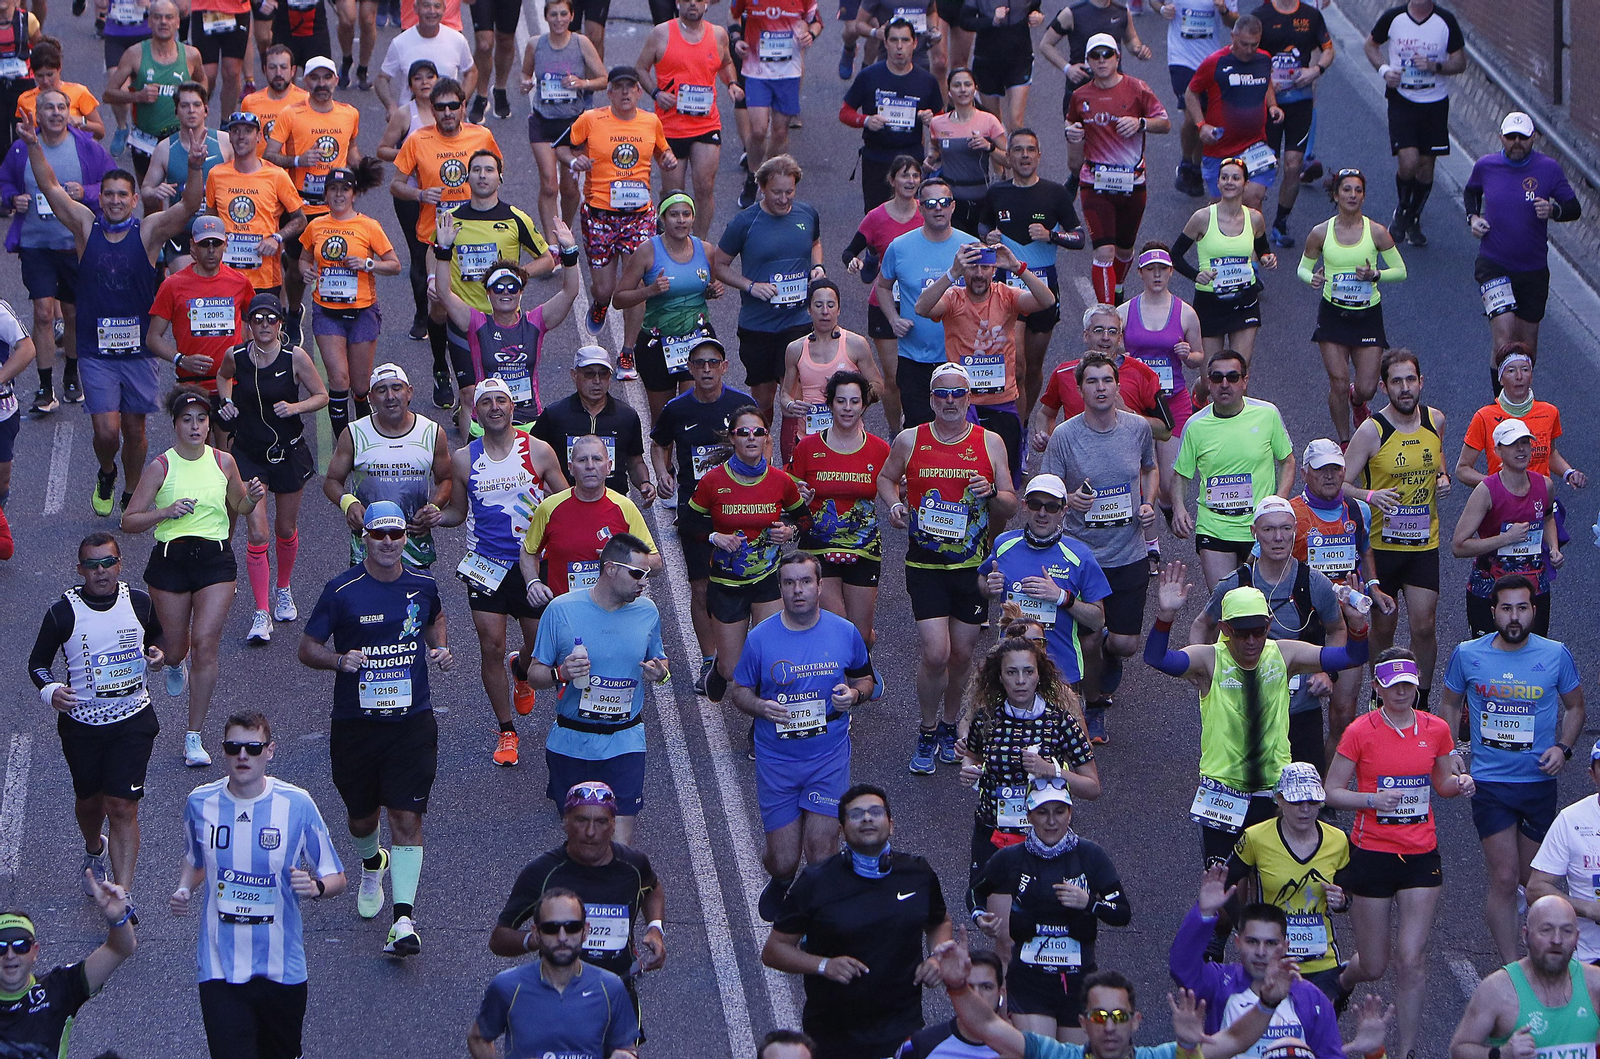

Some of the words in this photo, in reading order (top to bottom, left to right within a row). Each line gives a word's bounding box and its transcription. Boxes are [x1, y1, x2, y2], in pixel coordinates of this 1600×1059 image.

[436, 151, 468, 160] PAMPLONA
[612, 156, 638, 169] RUNNERS
[228, 188, 259, 196] PAMPLONA
[1525, 191, 1535, 201] 50
[230, 210, 255, 224] RUNNERS
[322, 229, 356, 237] PAMPLONA
[235, 234, 259, 242] ZURICH
[1223, 257, 1247, 265] ZURICH
[784, 272, 806, 282] ZURICH
[1221, 278, 1243, 286] CRISTINA
[1485, 278, 1508, 291] ZURICH
[1342, 285, 1362, 293] 13472
[206, 299, 231, 307] ZURICH
[111, 319, 136, 327] ZURICH
[1143, 358, 1168, 366] ZURICH
[503, 371, 526, 380] ZURICH
[392, 462, 411, 470] CROSS
[479, 476, 516, 487] PINTURAS
[816, 472, 872, 484] INDEPENDIENTES
[1401, 477, 1426, 486] TEAM
[1099, 486, 1126, 497] ZURICH
[1220, 491, 1239, 500] 7152
[722, 503, 777, 515] INDEPENDIENTES
[936, 502, 964, 513] ZURICH
[1100, 503, 1119, 512] 9205
[1226, 501, 1249, 509] ANTONIO
[1400, 507, 1427, 515] ZURICH
[374, 517, 397, 527] URUGUAY
[930, 514, 955, 526] 12656
[1398, 521, 1418, 530] 7150
[1391, 531, 1423, 539] FRANCISCO
[1324, 537, 1351, 545] ZURICH
[1321, 550, 1345, 559] 14010
[474, 559, 497, 576] 12614
[1326, 562, 1353, 570] VETERANO
[468, 570, 487, 584] DANIEL
[1020, 599, 1043, 609] 12281
[362, 642, 418, 657] MARCELO
[109, 651, 138, 663] ZURICH
[82, 634, 95, 691] ZAPADOR
[362, 655, 417, 670] URUGUAY
[790, 661, 839, 673] FISIOTERAPIA
[109, 665, 133, 678] 12255
[375, 672, 406, 680] ZURICH
[797, 671, 812, 680] JULIO
[813, 668, 835, 677] CORRAL
[1502, 673, 1515, 682] edp
[96, 682, 120, 692] CARLOS
[121, 676, 143, 689] ZAPADOR
[603, 679, 632, 688] ZURICH
[373, 687, 399, 696] 12196
[1475, 684, 1545, 700] MADRID
[599, 695, 621, 704] 9402
[788, 692, 818, 702] ZURICH
[376, 700, 396, 708] CHELO
[593, 704, 606, 712] PAPI
[608, 705, 622, 713] PAPI
[790, 709, 812, 719] 8778
[1497, 705, 1529, 714] ZURICH
[797, 719, 821, 729] MANUEL
[1494, 719, 1520, 729] 11870
[1497, 733, 1515, 741] SAMU
[1397, 778, 1426, 787] ZURICH
[1209, 797, 1235, 811] 12090
[1203, 809, 1219, 819] JOHN
[1219, 813, 1233, 823] WAR
[210, 825, 230, 850] 10
[237, 874, 272, 886] ZURICH
[231, 889, 261, 902] 12282
[235, 905, 253, 914] STEF
[588, 907, 623, 916] ZURICH
[1289, 916, 1319, 925] ZURICH
[587, 926, 611, 936] 9272
[1042, 925, 1068, 933] ZURIC
[1286, 932, 1314, 942] 13068
[588, 939, 607, 947] BERT
[1033, 955, 1069, 963] CHRISTINE
[1266, 1028, 1296, 1038] URICH
